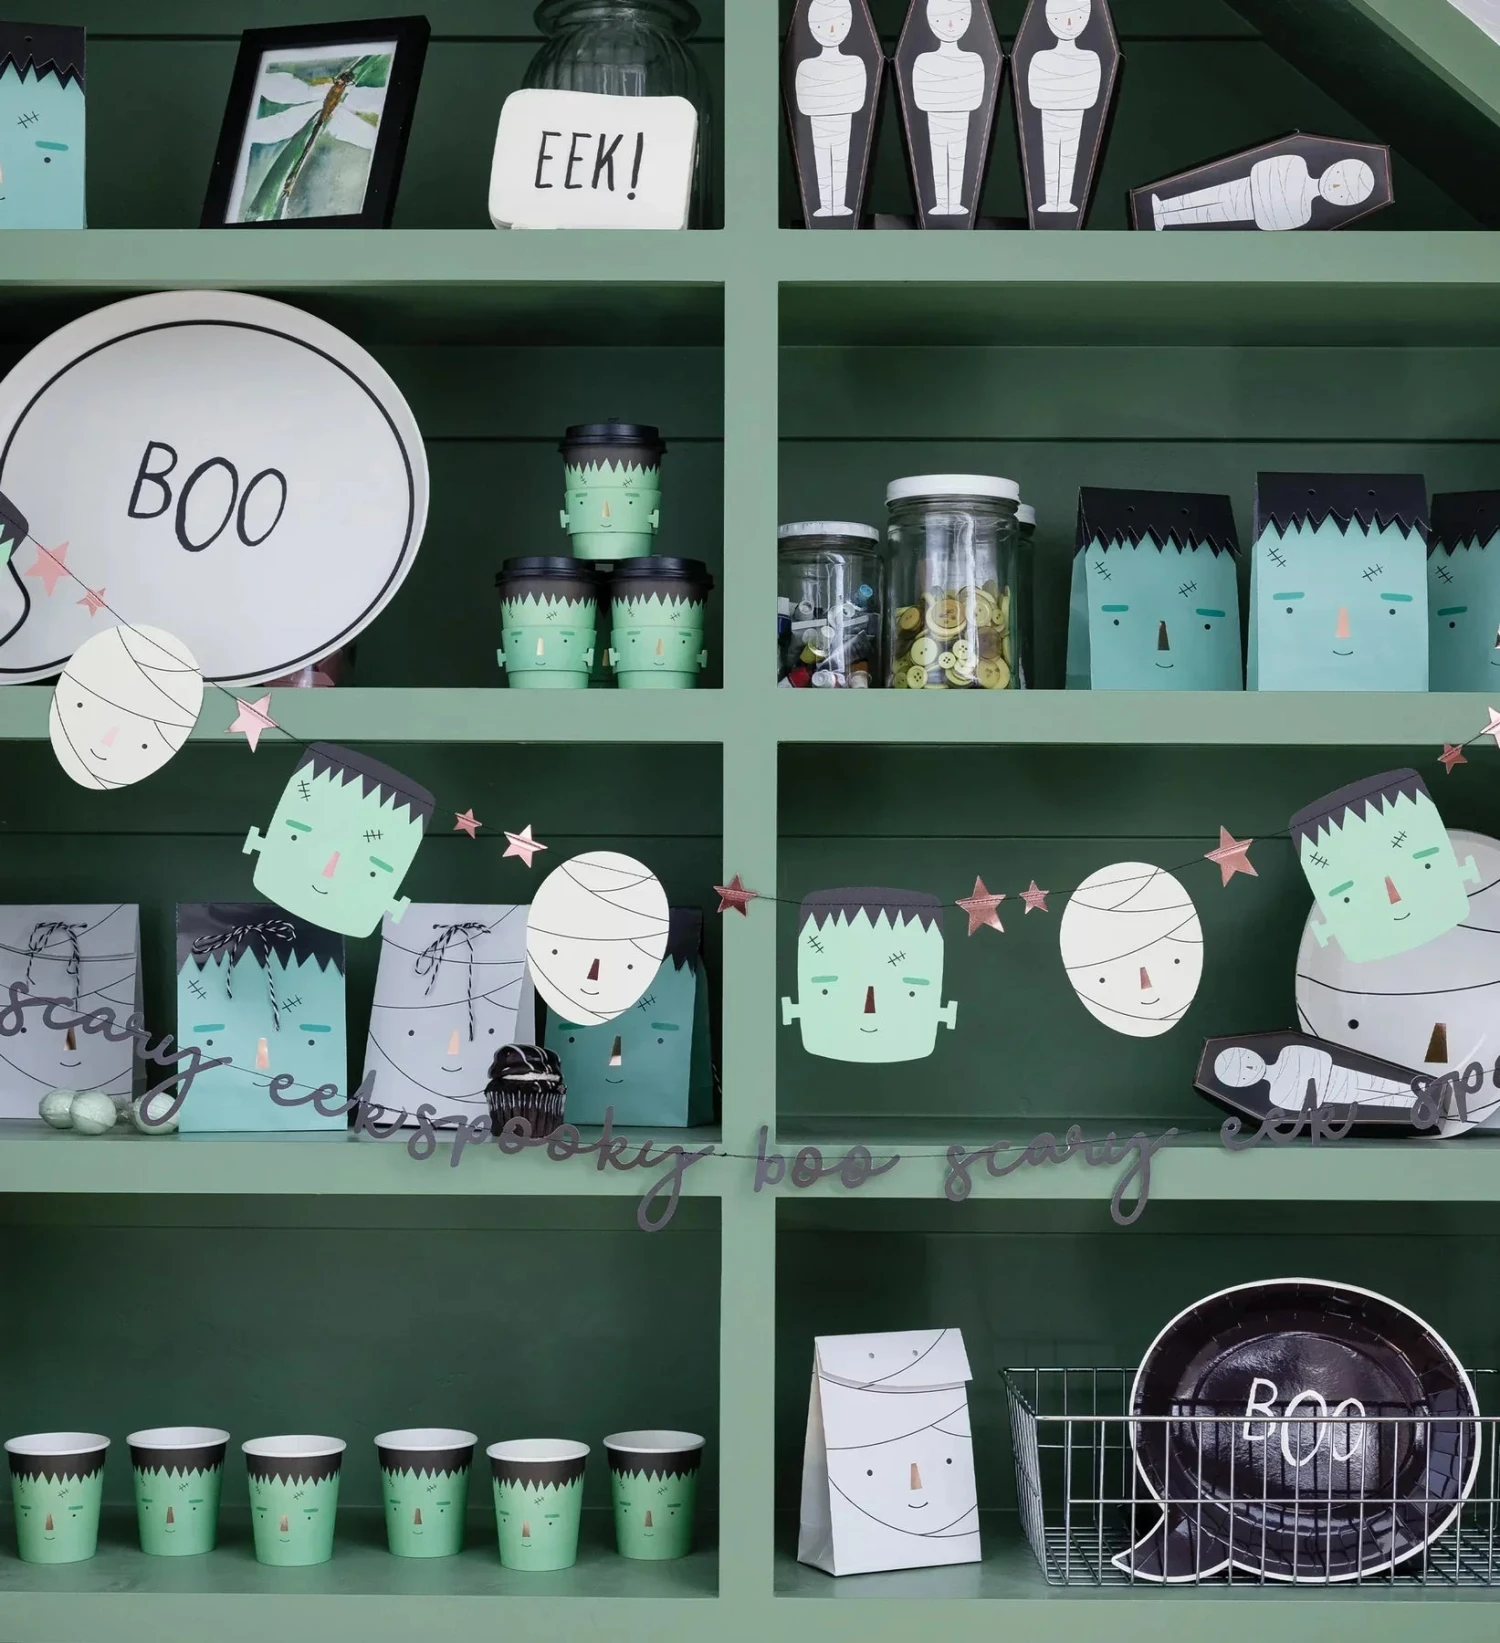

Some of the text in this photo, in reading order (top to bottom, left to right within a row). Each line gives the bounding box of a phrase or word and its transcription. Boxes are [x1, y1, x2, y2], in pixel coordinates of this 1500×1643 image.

[535, 131, 643, 200] EEK!
[128, 440, 287, 552] BOO
[0, 981, 1500, 1232] scary eek spooky boo scary eek sp
[1243, 1377, 1366, 1467] BOO
